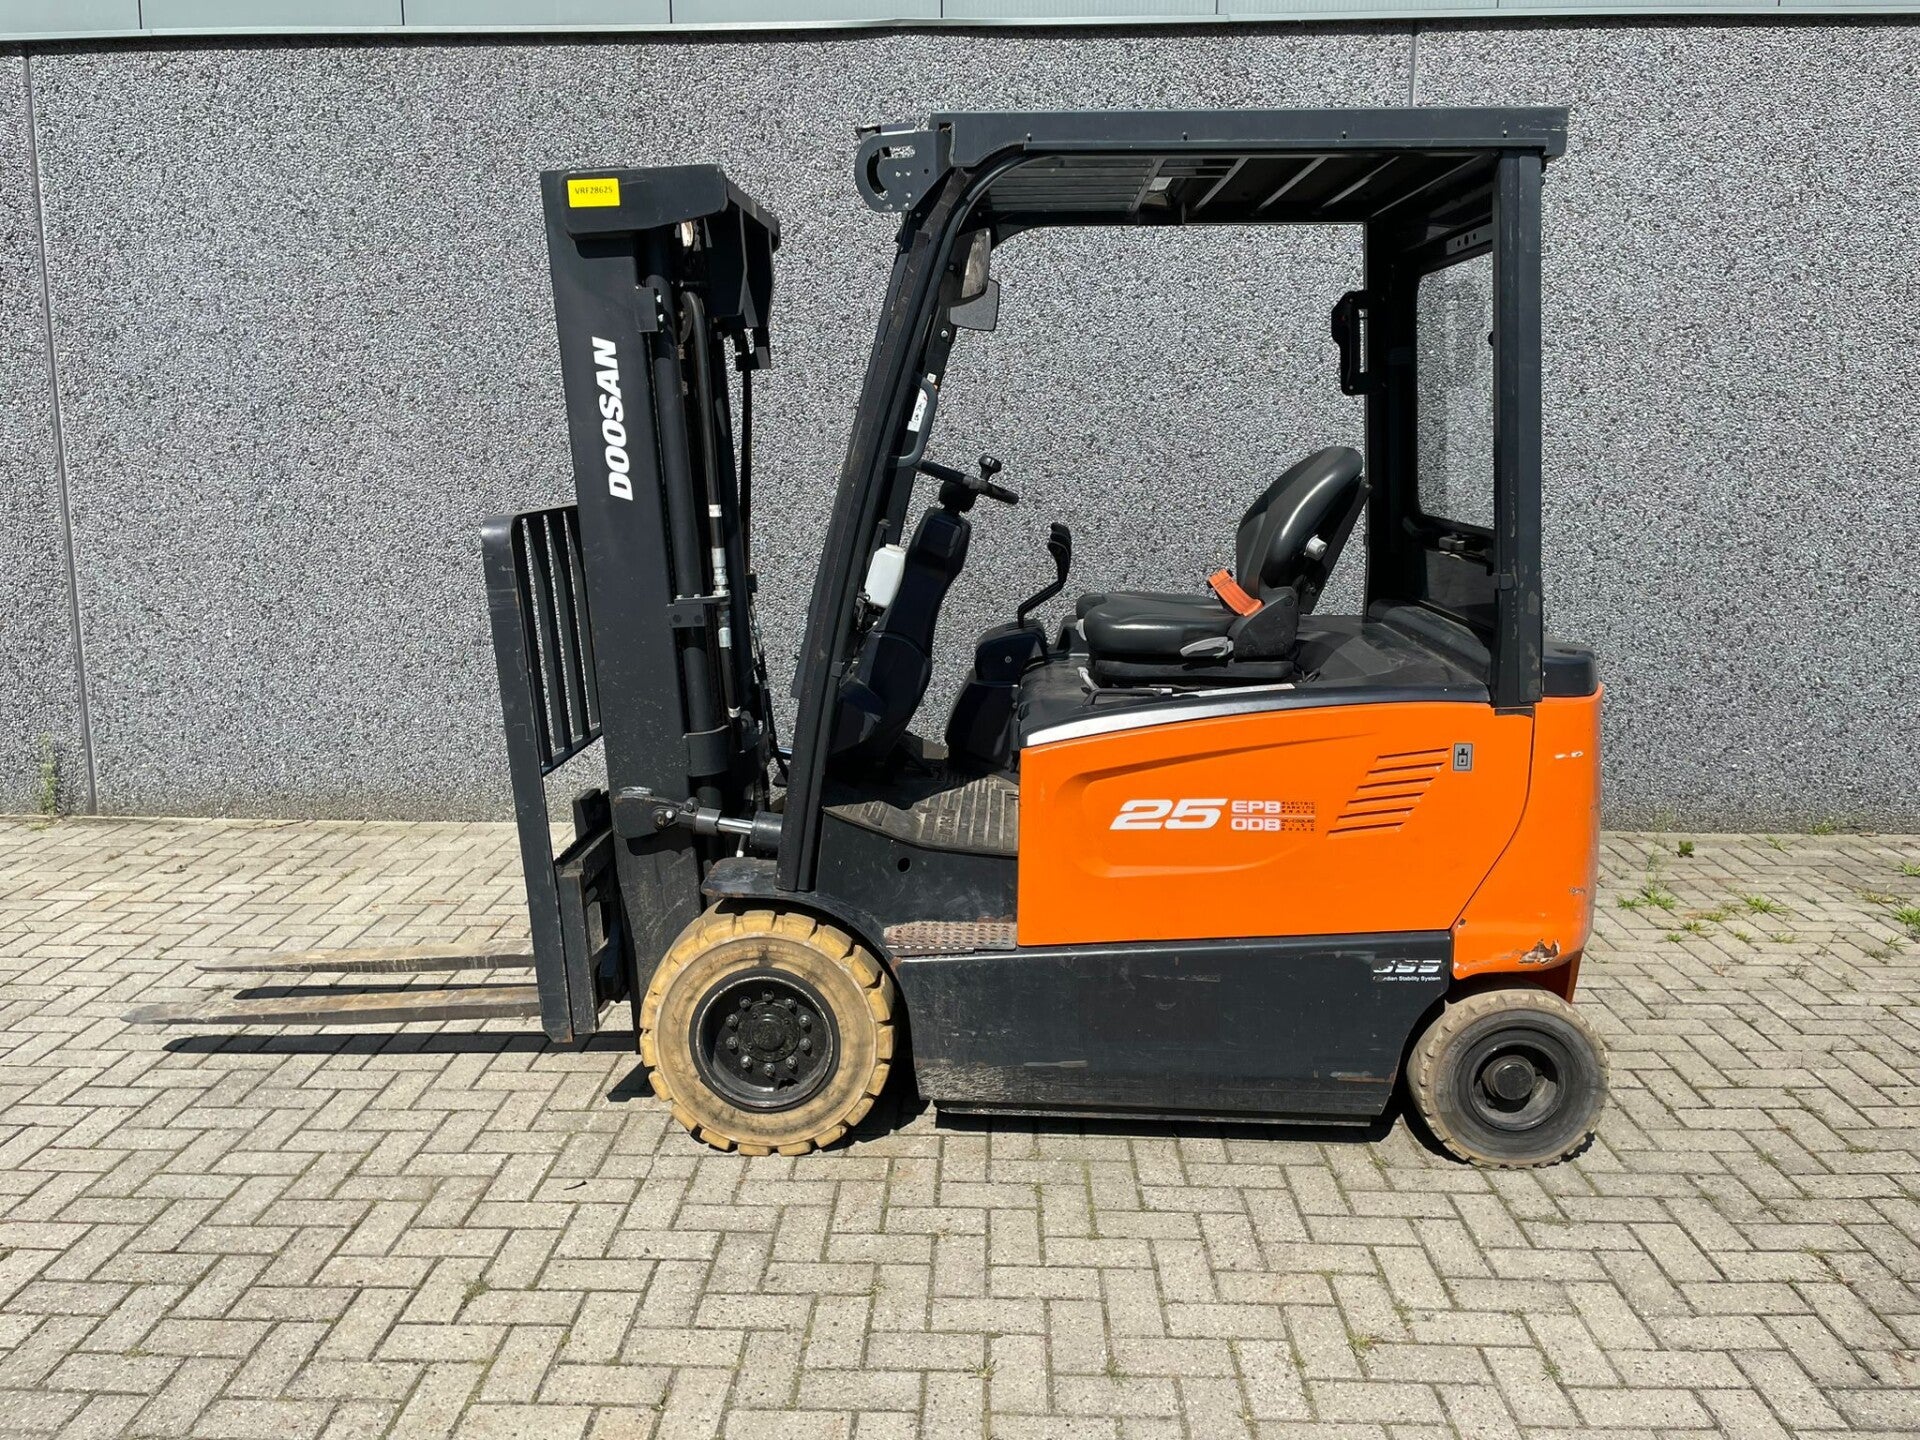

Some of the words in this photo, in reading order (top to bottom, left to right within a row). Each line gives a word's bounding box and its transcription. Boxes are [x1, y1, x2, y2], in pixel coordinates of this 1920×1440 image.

[591, 336, 634, 501] DOOSAN
[1109, 798, 1228, 830] 25
[1231, 800, 1281, 813] EPB
[1231, 817, 1281, 831] ODB
